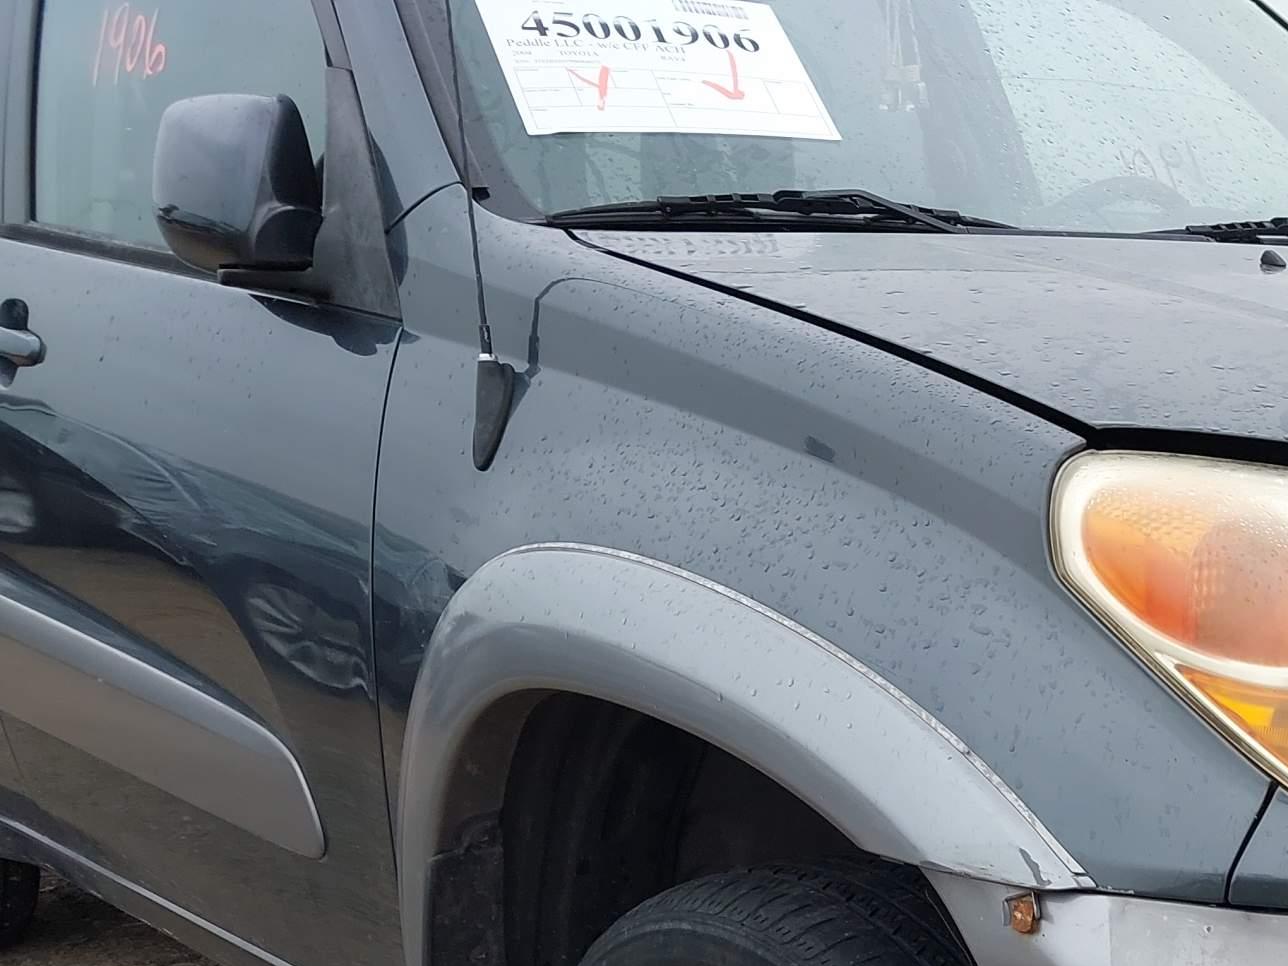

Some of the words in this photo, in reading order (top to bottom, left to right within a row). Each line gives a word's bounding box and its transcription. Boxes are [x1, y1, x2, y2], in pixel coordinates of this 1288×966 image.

[92, 2, 166, 88] 1906
[506, 38, 552, 48] Peddle
[554, 39, 583, 48] LLC
[521, 10, 760, 53] 45001906
